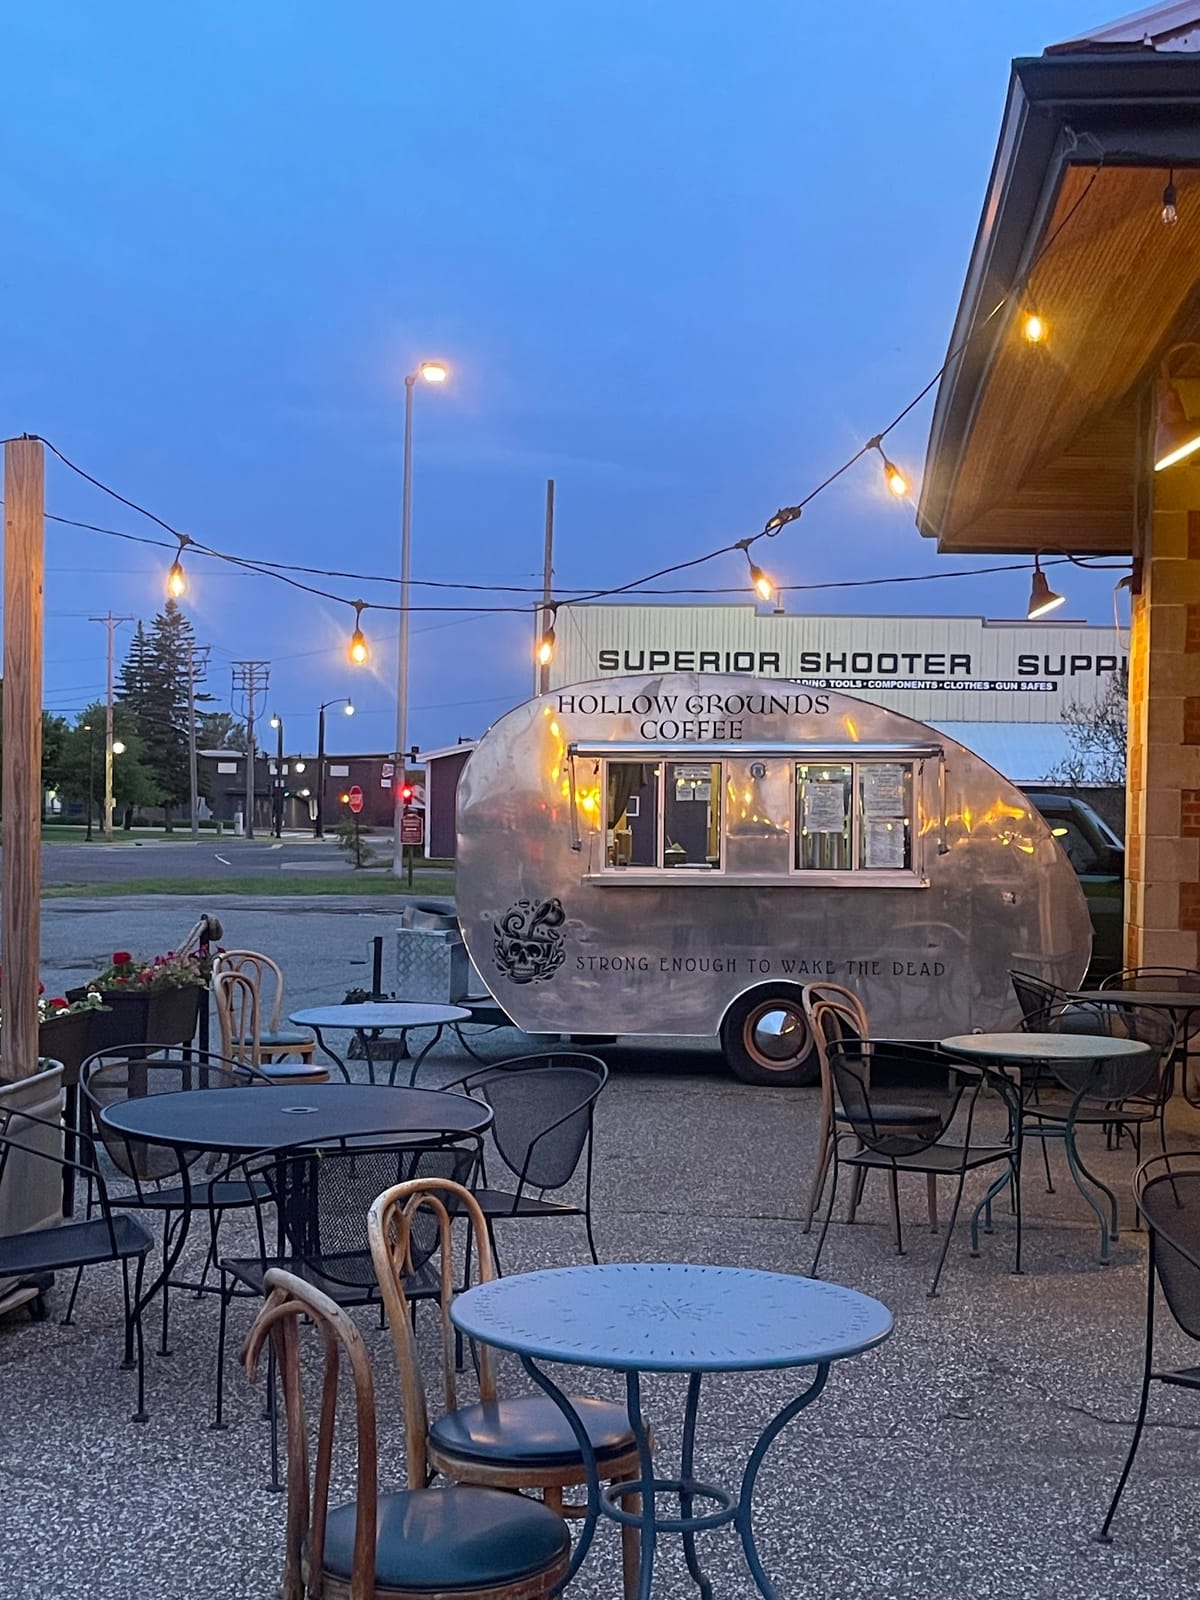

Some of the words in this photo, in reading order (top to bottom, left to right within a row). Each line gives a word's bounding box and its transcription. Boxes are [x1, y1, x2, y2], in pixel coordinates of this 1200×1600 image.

[599, 650, 780, 673] SUPERIOR
[800, 652, 972, 675] SHOOTER
[829, 680, 862, 689] TOOLS
[868, 680, 938, 690] COMPONENTS
[943, 681, 990, 690] CLOTHES
[995, 682, 1018, 690] GUN
[1020, 682, 1053, 690] SAFES
[556, 694, 678, 715] HOLLOW
[685, 693, 830, 716] GROUNDS
[640, 719, 745, 740] COFFEE
[576, 956, 649, 971] STRONG
[659, 957, 737, 973] ENOUGH
[747, 959, 771, 974] TO
[781, 959, 836, 975] WAKE
[846, 960, 881, 976] THE
[893, 962, 946, 977] DEAD
